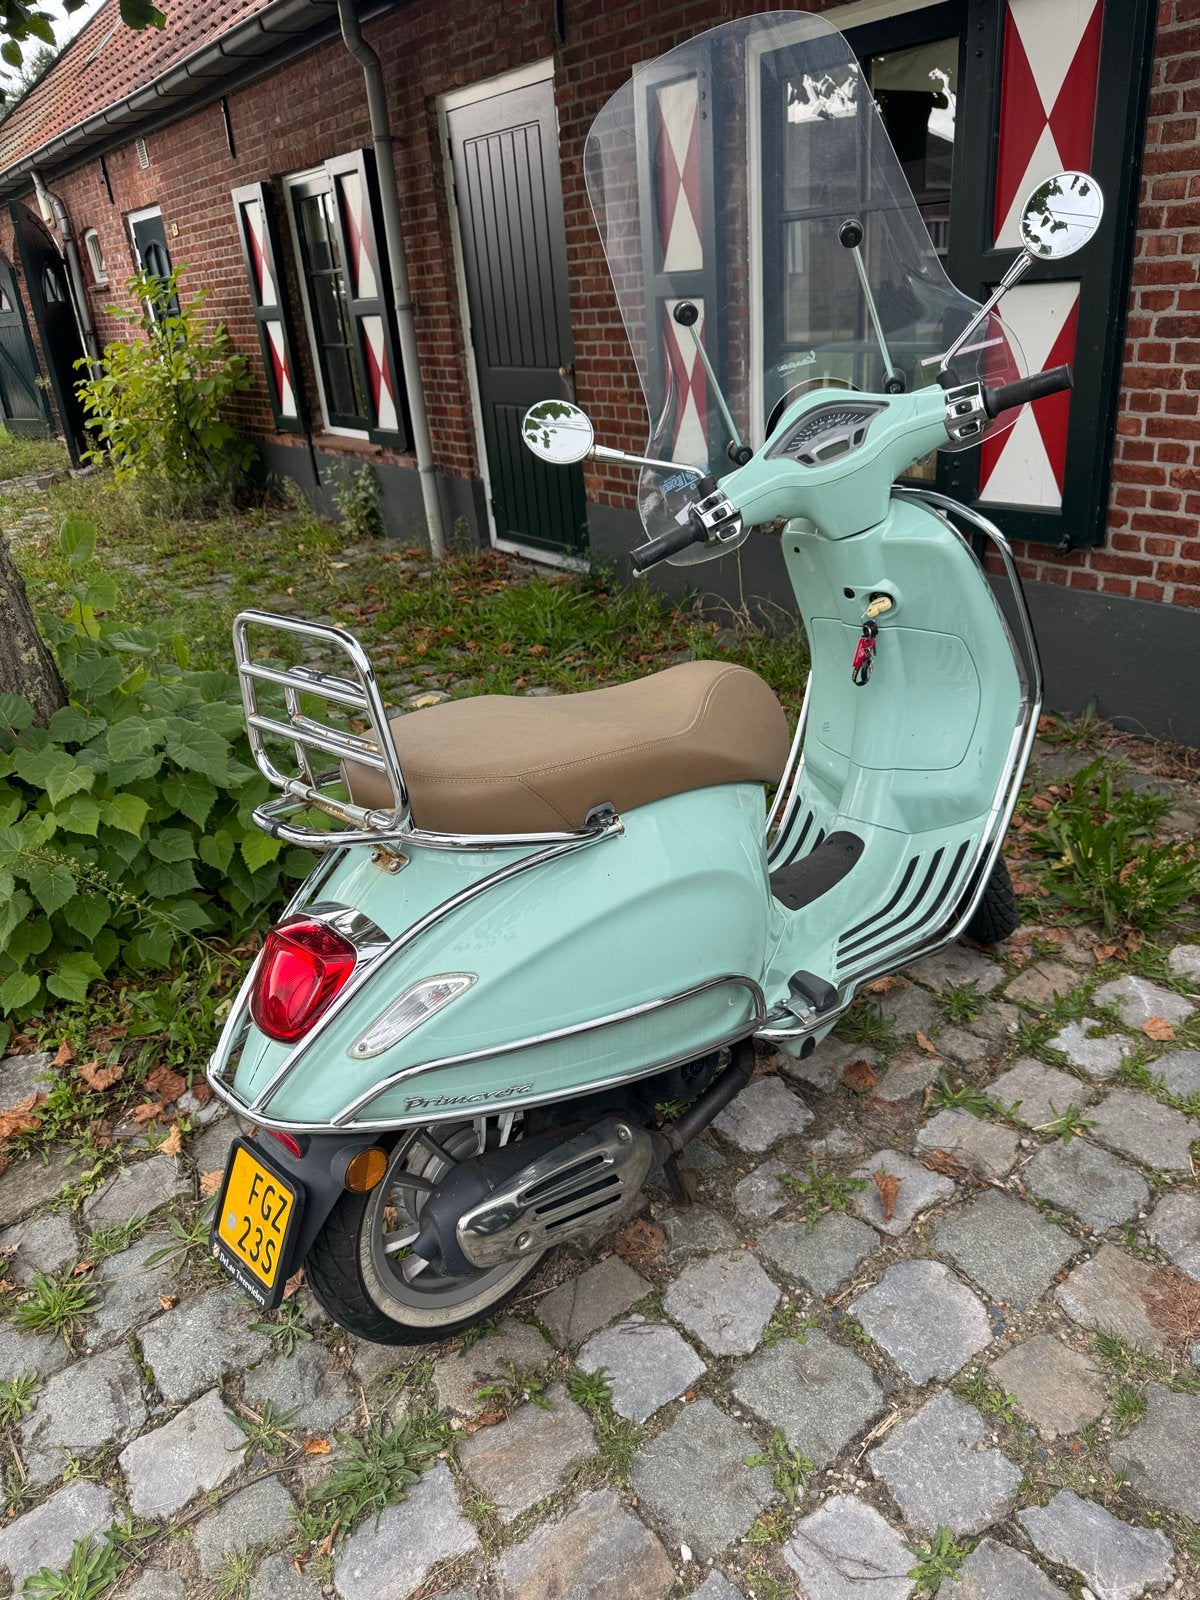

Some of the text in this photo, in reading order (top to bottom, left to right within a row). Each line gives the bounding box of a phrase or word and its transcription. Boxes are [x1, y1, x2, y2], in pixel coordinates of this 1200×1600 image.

[404, 1083, 533, 1112] Primavera
[249, 1173, 288, 1233] FGZ
[237, 1215, 276, 1275] 23S
